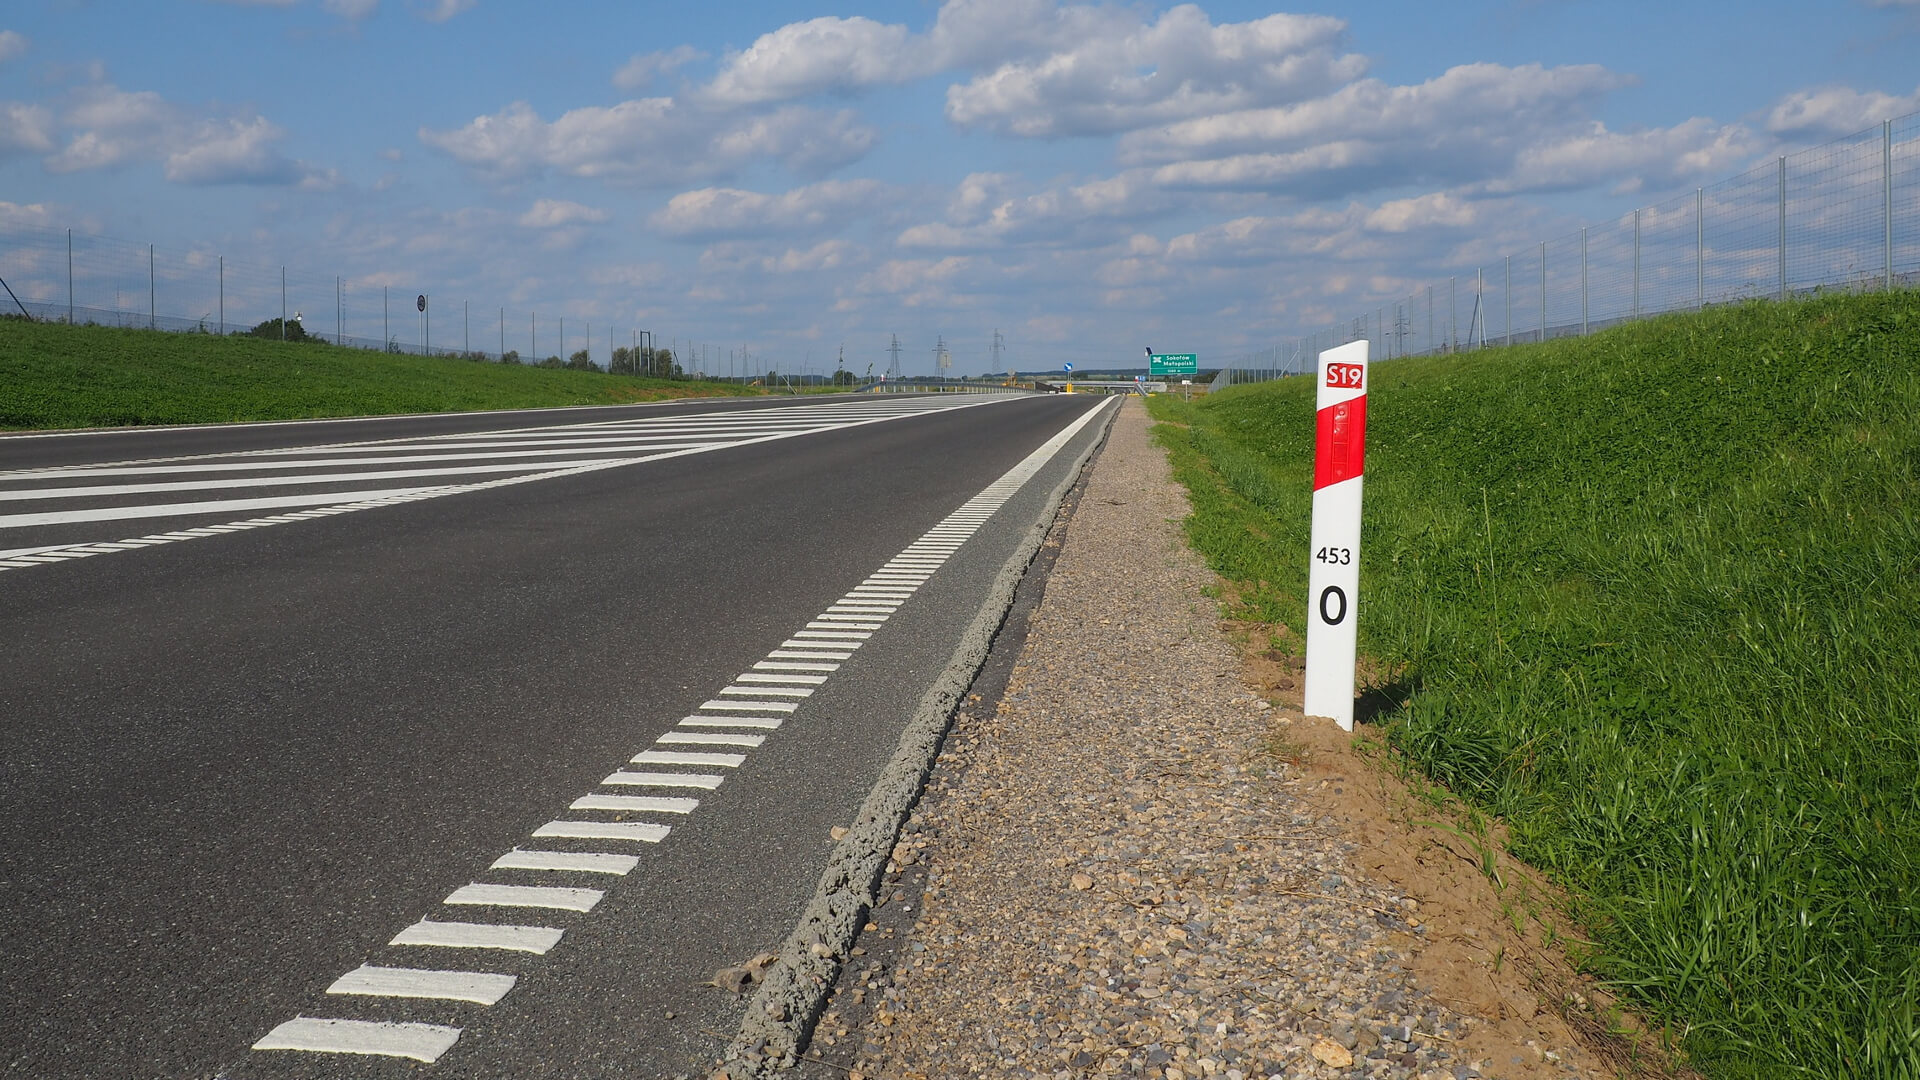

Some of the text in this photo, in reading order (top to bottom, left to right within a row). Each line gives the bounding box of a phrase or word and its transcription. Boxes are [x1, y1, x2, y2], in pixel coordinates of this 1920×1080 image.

[1327, 365, 1362, 386] S19
[1316, 546, 1351, 566] 453
[1320, 585, 1347, 626] 0
